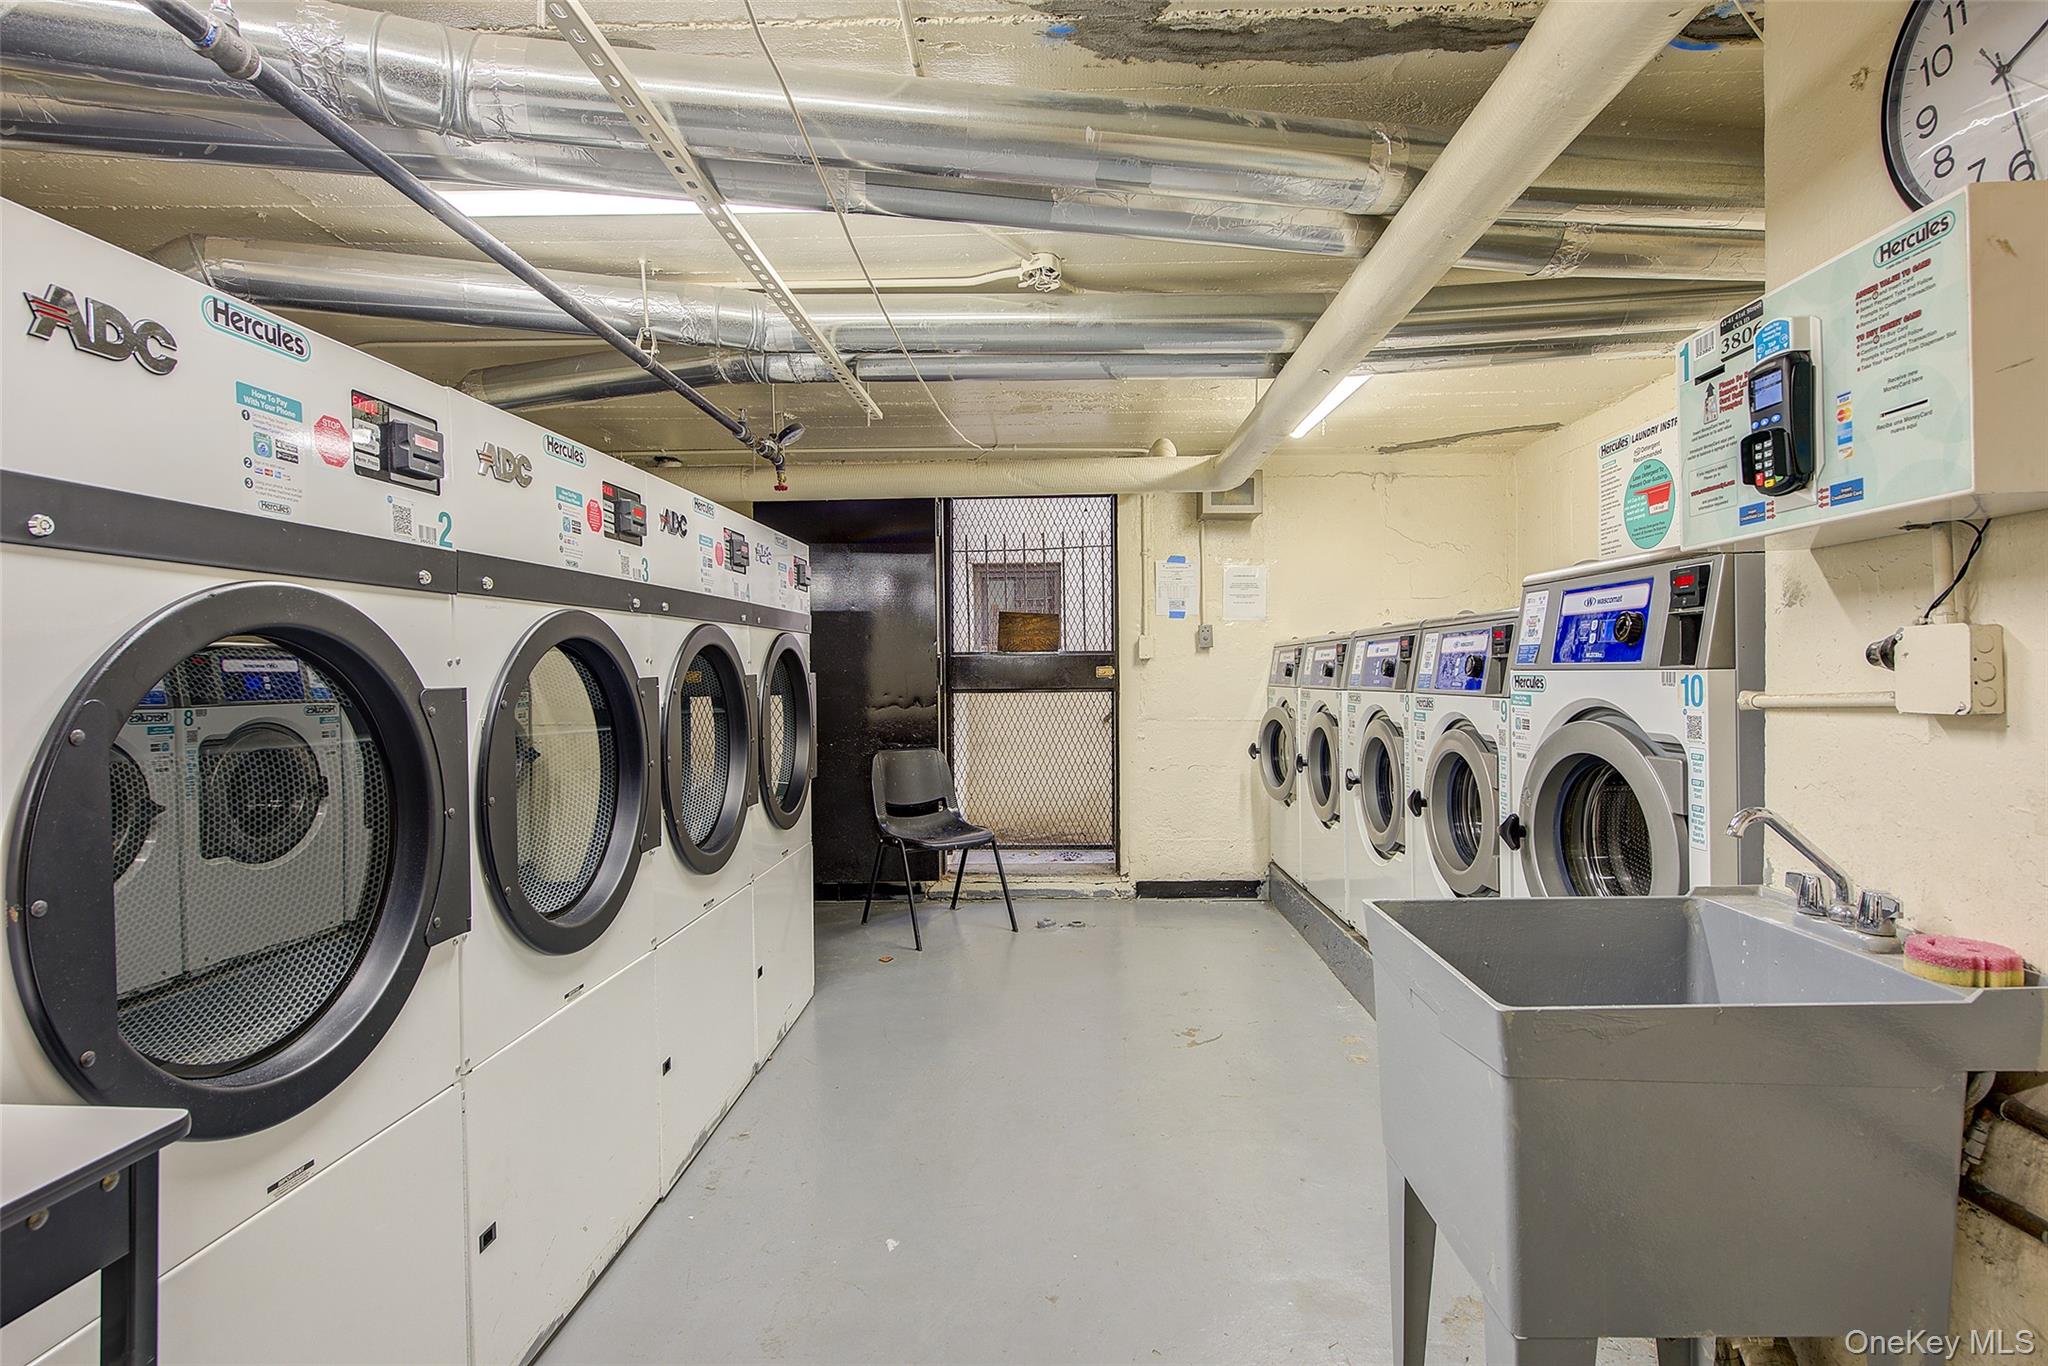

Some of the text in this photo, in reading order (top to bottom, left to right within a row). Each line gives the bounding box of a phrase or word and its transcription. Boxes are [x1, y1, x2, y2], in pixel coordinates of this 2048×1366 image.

[1943, 0, 1967, 35] 11
[1920, 44, 1953, 87] 10
[1916, 105, 1938, 139] 9
[1933, 145, 1955, 178] 8
[1967, 157, 1986, 182] 7
[2009, 149, 2036, 181] 6
[1880, 217, 1950, 262] Hercules
[1902, 276, 1914, 284] Card
[1894, 289, 1906, 298] Type
[212, 298, 305, 356] Hercules
[1878, 311, 1890, 320] Card
[23, 282, 177, 375] ADC
[1896, 325, 1909, 333] Card
[1680, 342, 1689, 382] 1
[1894, 349, 1906, 358] Card
[1882, 375, 1924, 393] MoneyCard here
[1907, 369, 1918, 377] new
[243, 395, 297, 418] With Your Phone
[251, 389, 288, 408] How To Pay
[321, 418, 341, 430] STOP
[1904, 409, 1933, 423] MoneyCard
[546, 435, 584, 464] Hercules
[1600, 437, 1629, 456] Hercules
[1631, 425, 1659, 443] LAUNDRY
[476, 441, 533, 488] ADC
[260, 501, 290, 514] Hercules
[438, 512, 453, 548] 2
[659, 508, 688, 538] ADC
[641, 558, 649, 582] 3
[1597, 595, 1623, 605] wascomat
[1514, 675, 1544, 689] Hercules
[1680, 674, 1704, 707] 10
[1501, 700, 1508, 723] 9
